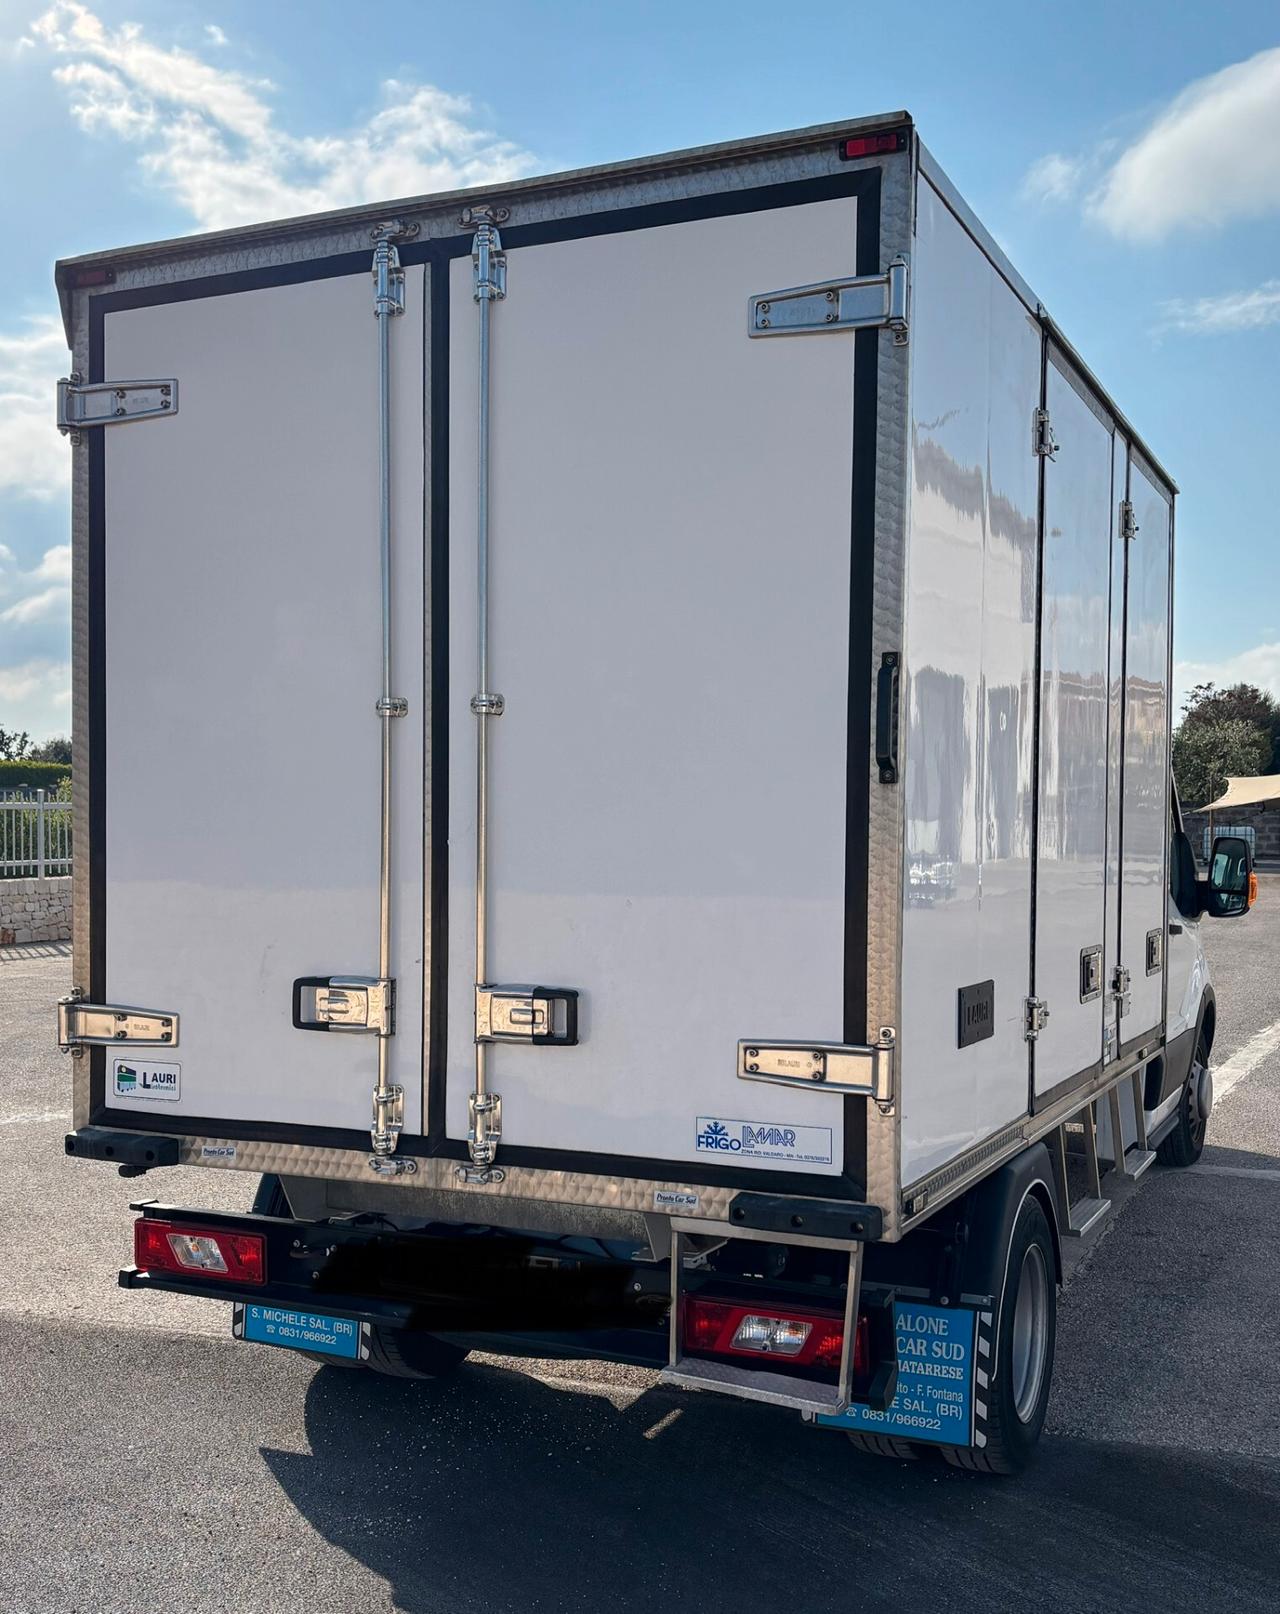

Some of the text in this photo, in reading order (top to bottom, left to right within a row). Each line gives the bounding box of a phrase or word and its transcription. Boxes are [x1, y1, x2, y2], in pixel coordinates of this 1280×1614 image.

[142, 1071, 176, 1089] LAURI
[697, 1125, 796, 1151] FRIGO LAMAR
[675, 1195, 685, 1203] Car
[685, 1195, 697, 1204] Sud
[251, 1307, 353, 1337] S. MICHELE SAL. (BR)
[278, 1326, 337, 1345] 0831/966922
[895, 1337, 965, 1361] CAR SUD
[917, 1384, 925, 1397] F.
[926, 1385, 964, 1403] Fontana
[862, 1408, 942, 1431] 0831/966922
[903, 1398, 933, 1414] SAL.
[935, 1404, 963, 1421] (BR)
